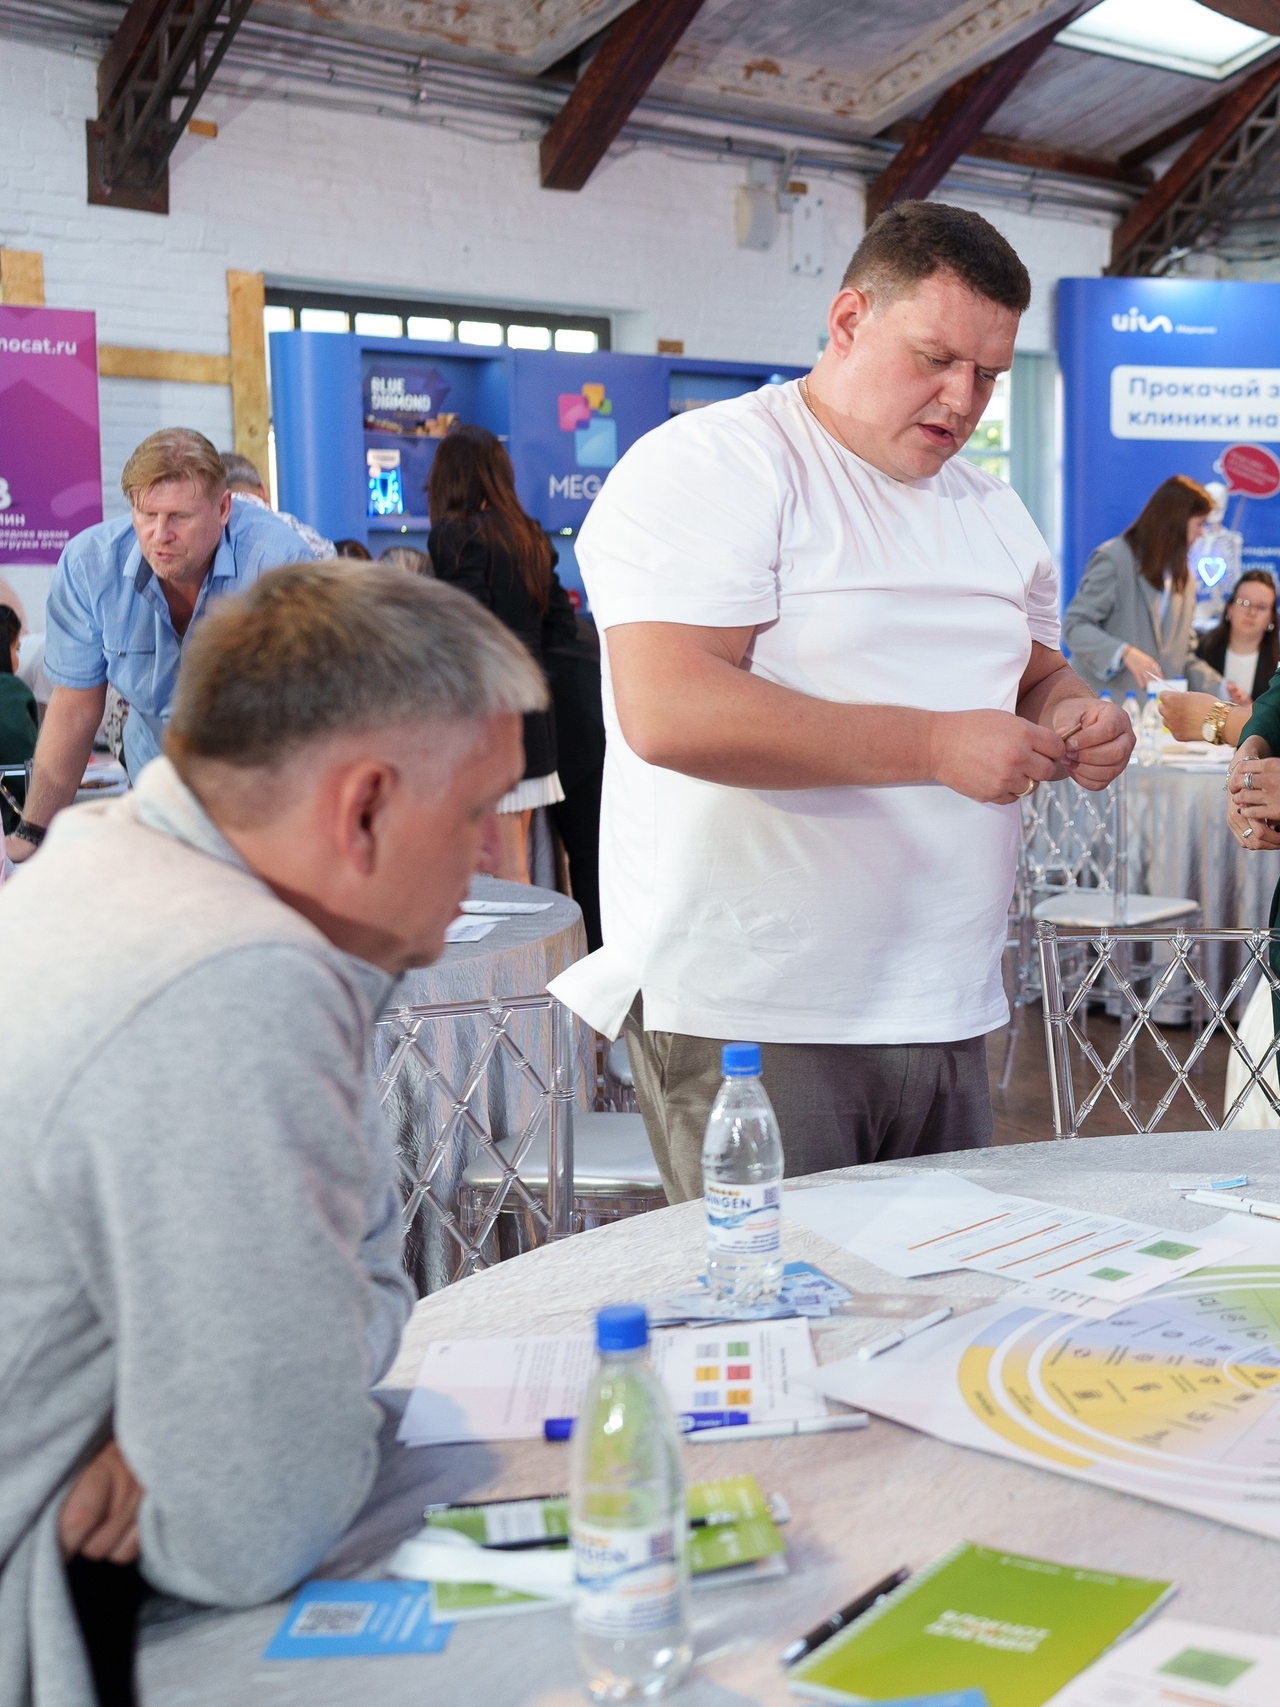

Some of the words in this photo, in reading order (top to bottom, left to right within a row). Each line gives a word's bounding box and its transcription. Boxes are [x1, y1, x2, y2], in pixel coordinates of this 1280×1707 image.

[371, 376, 405, 394] BLUE
[1128, 376, 1261, 399] Прокачай
[371, 392, 432, 413] DIAMOND
[1128, 410, 1240, 428] клиники
[1248, 412, 1279, 429] на
